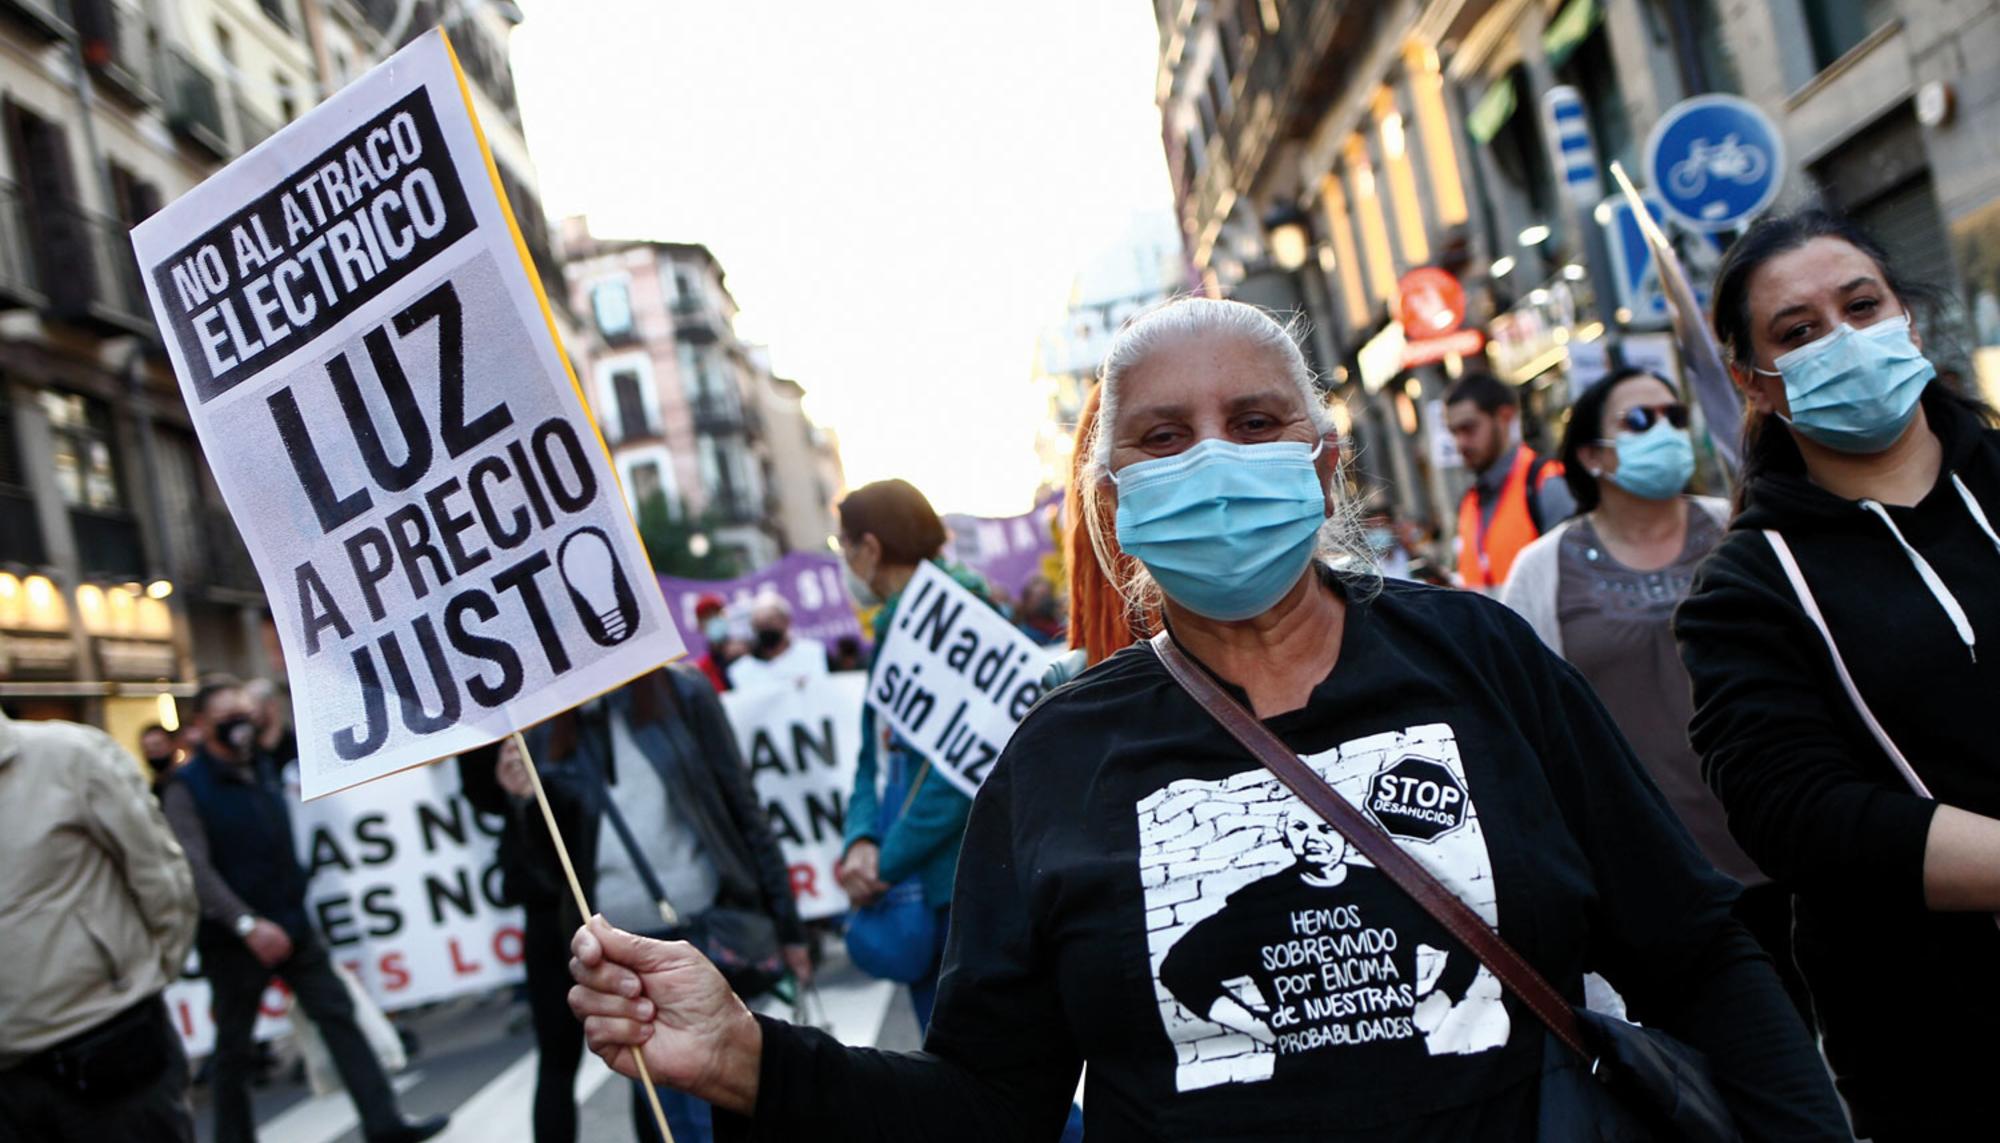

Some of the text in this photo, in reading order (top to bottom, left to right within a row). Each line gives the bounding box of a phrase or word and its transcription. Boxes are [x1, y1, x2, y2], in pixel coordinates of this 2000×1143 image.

[171, 111, 423, 312] NO AL ATRACO
[191, 168, 447, 378] ELECTRICO
[266, 280, 515, 535] LUZ
[294, 416, 597, 657] A PRECIO
[752, 716, 836, 776] AN
[877, 664, 1001, 776] sin luz
[767, 790, 845, 846] AN
[1373, 799, 1456, 827] DESAHUCIOS
[1378, 774, 1460, 810] STOP
[1291, 904, 1361, 935] HEMOS
[1272, 983, 1415, 1028] de NUESTRAS
[1274, 953, 1400, 1003] por ENCIMA
